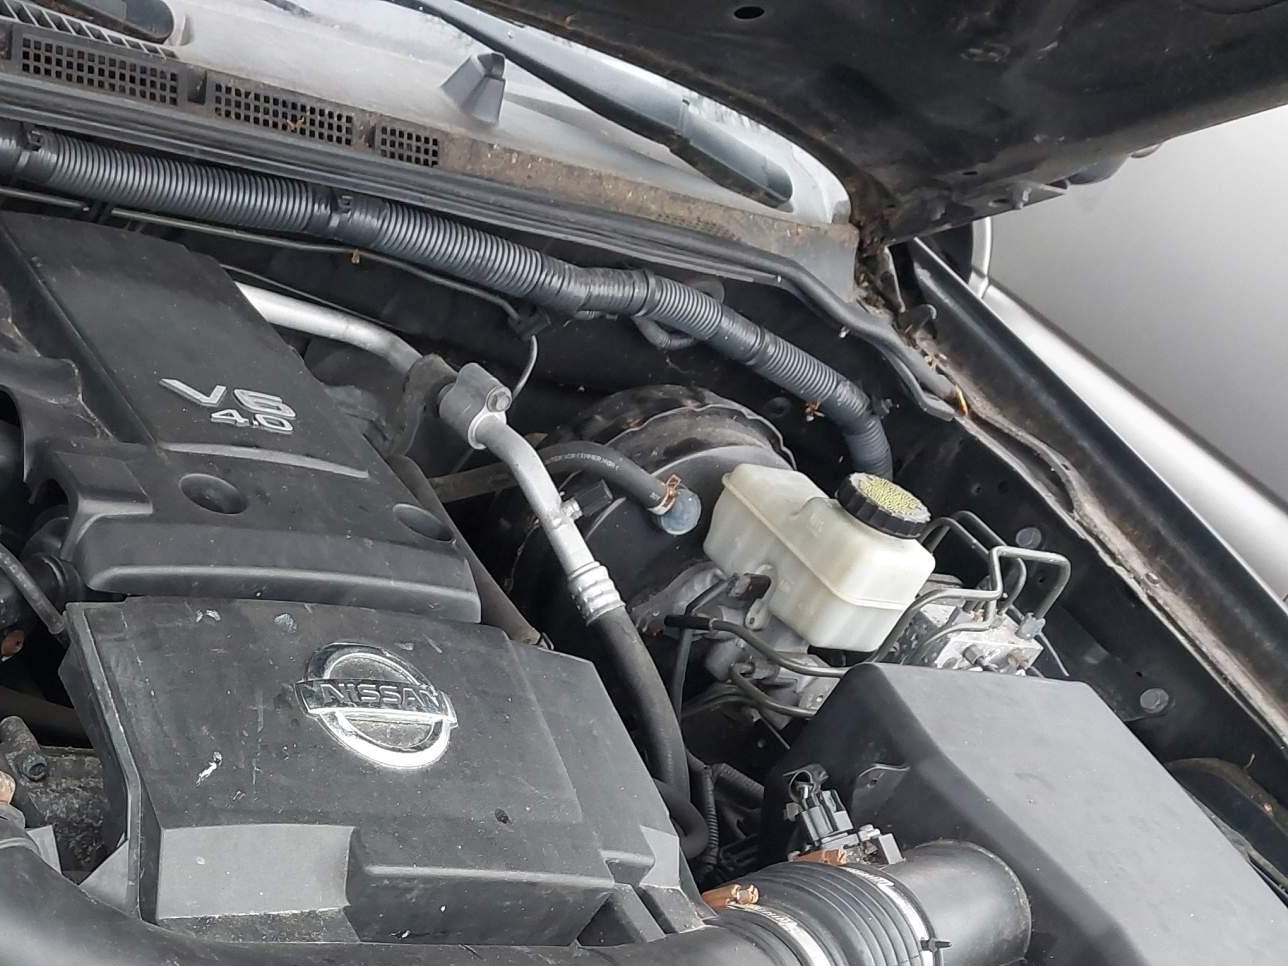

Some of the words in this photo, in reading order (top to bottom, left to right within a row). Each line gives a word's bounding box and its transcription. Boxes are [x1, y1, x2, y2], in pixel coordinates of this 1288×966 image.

[159, 378, 297, 421] V6
[210, 408, 295, 436] 4.0
[318, 682, 442, 715] NISSAN
